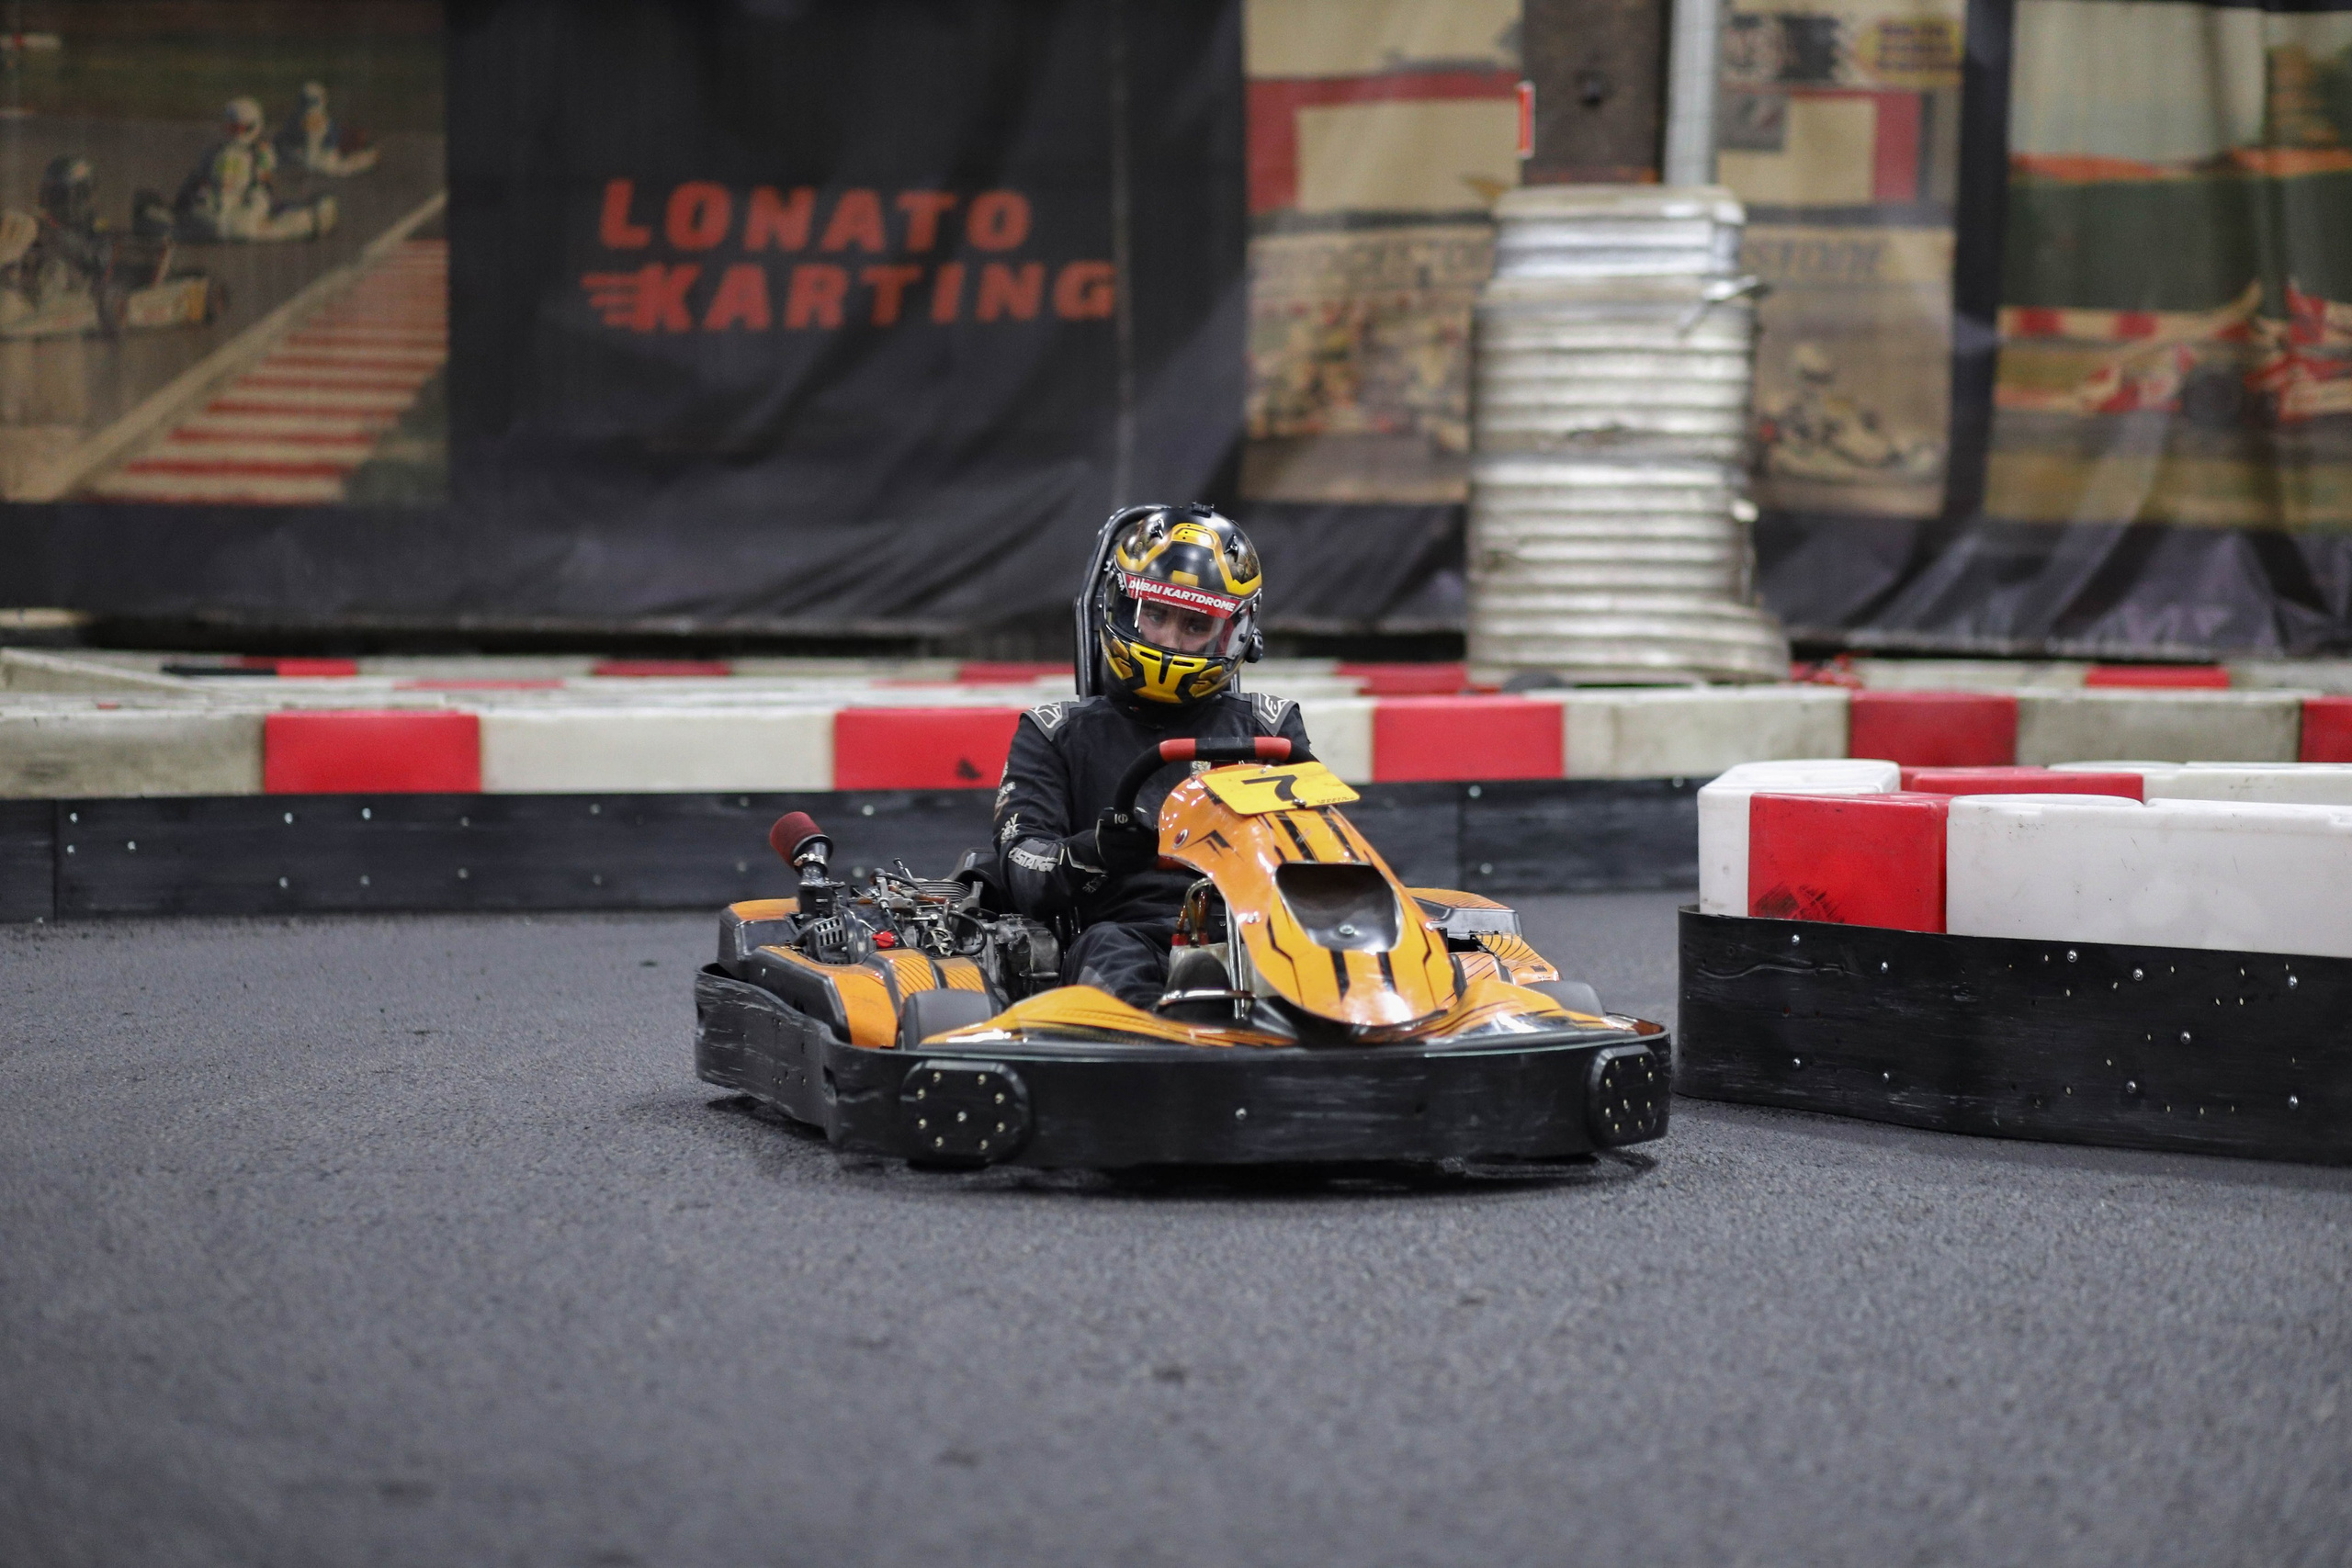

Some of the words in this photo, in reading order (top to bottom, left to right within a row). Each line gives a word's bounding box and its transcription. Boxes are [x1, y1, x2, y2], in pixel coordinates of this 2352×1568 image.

[600, 179, 1030, 252] LONATO
[582, 262, 1117, 331] KARTING
[1128, 580, 1163, 594] DUBAI
[1163, 586, 1237, 613] KARTDROME
[1241, 774, 1301, 802] 7
